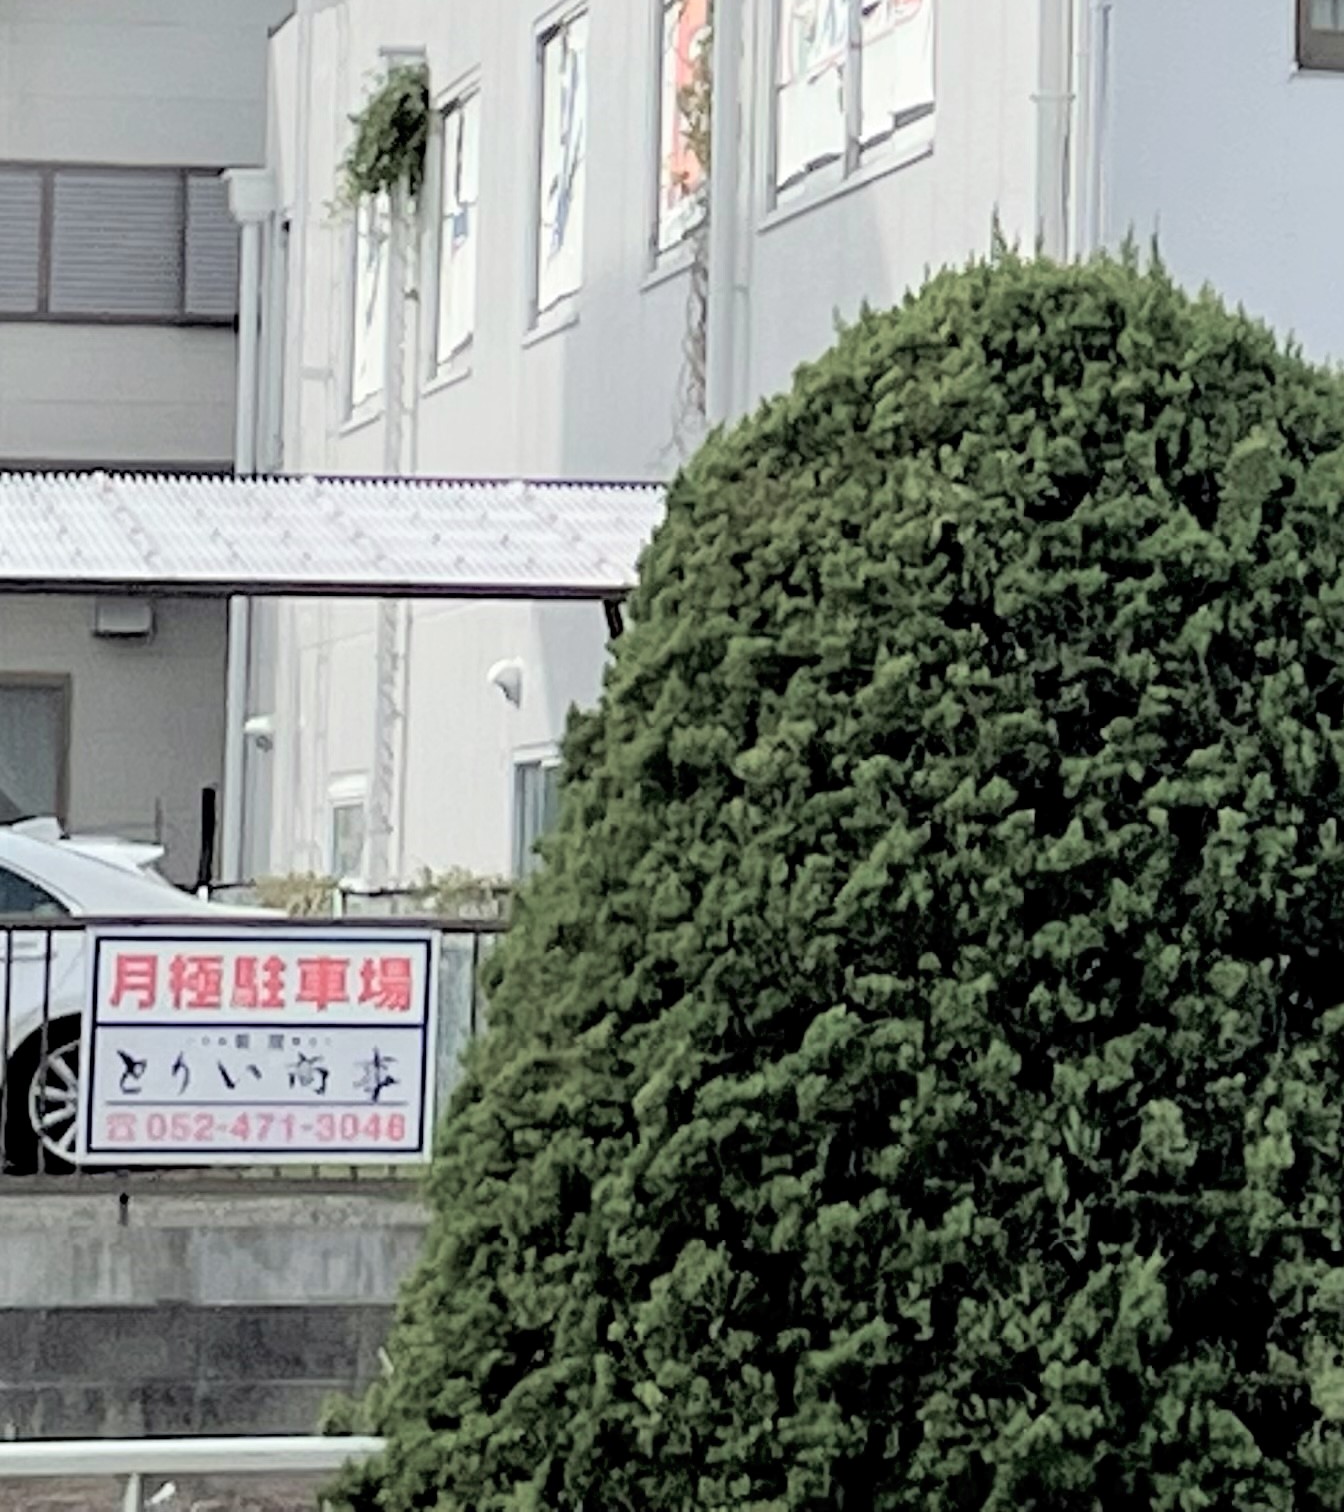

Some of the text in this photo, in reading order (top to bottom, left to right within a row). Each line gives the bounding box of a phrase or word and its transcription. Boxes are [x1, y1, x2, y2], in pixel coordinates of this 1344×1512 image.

[109, 953, 413, 1012] 月極駐車場
